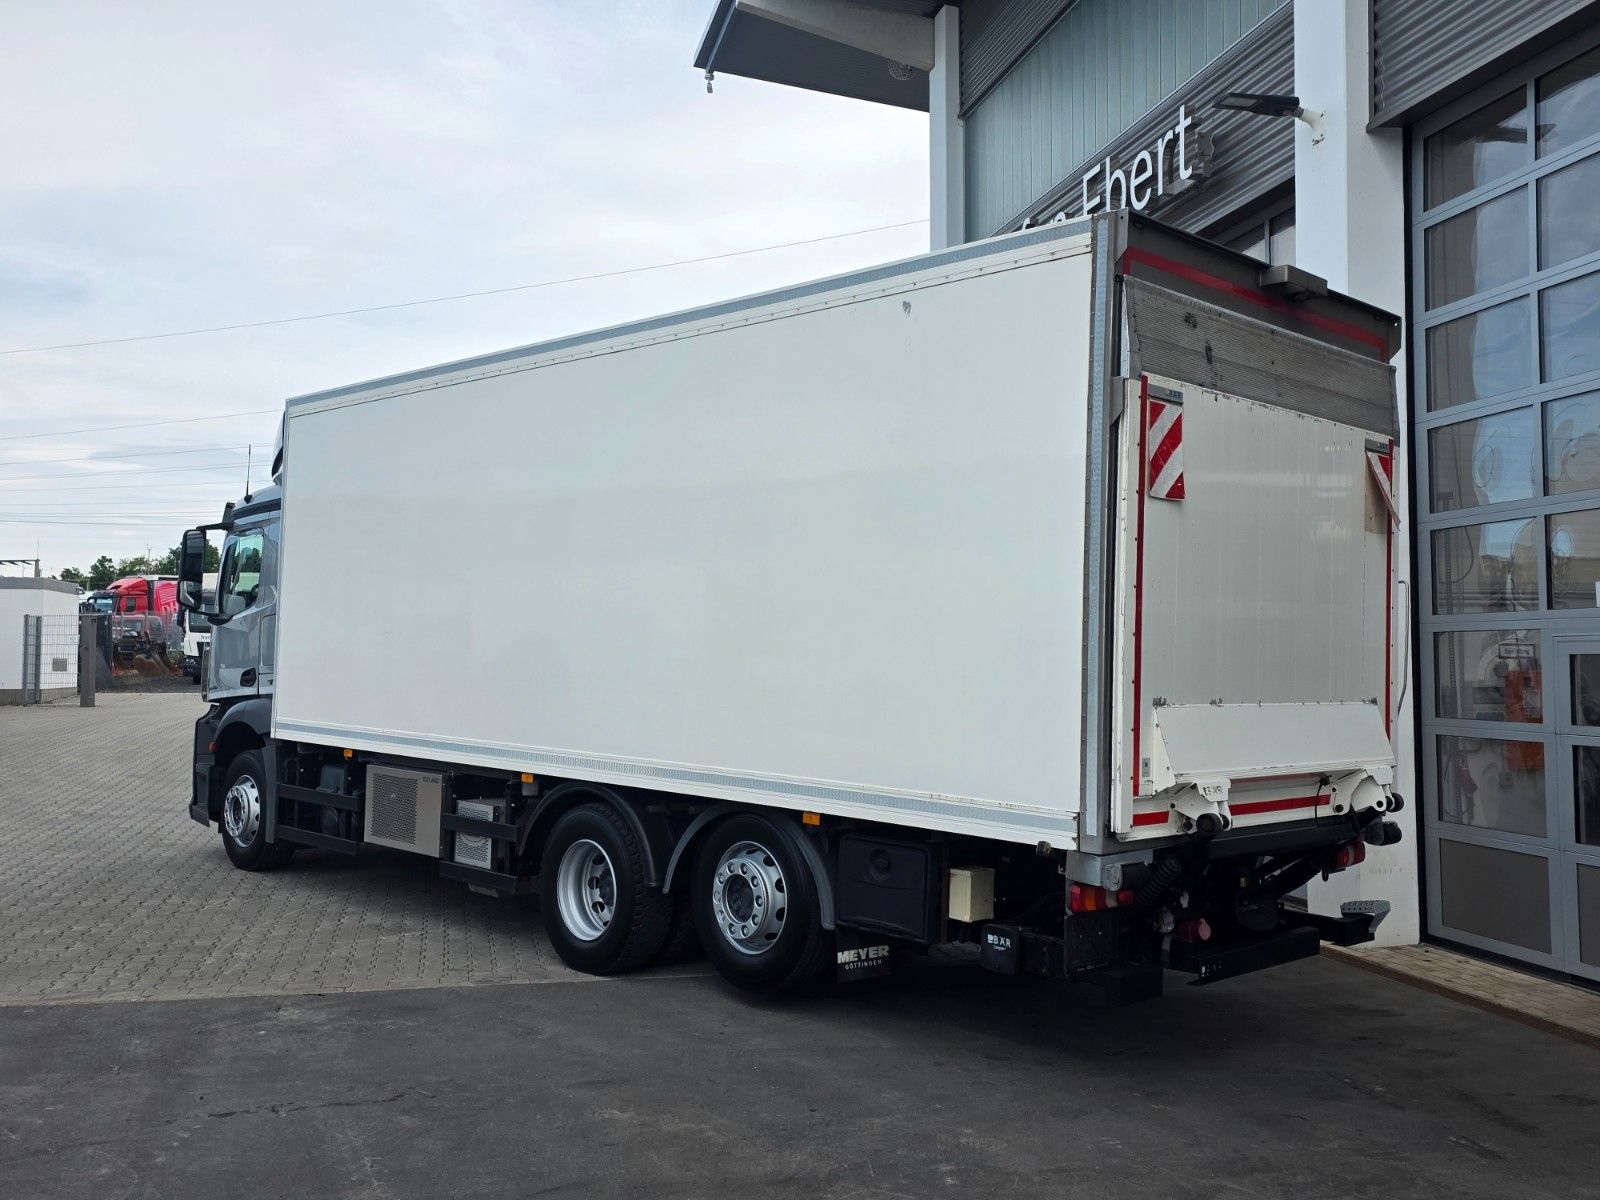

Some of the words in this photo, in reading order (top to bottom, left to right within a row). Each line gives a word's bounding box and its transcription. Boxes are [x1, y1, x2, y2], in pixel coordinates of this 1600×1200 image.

[1082, 104, 1193, 217] Ebert
[837, 945, 890, 964] MEYER
[844, 959, 882, 970] GÖTTINGEN
